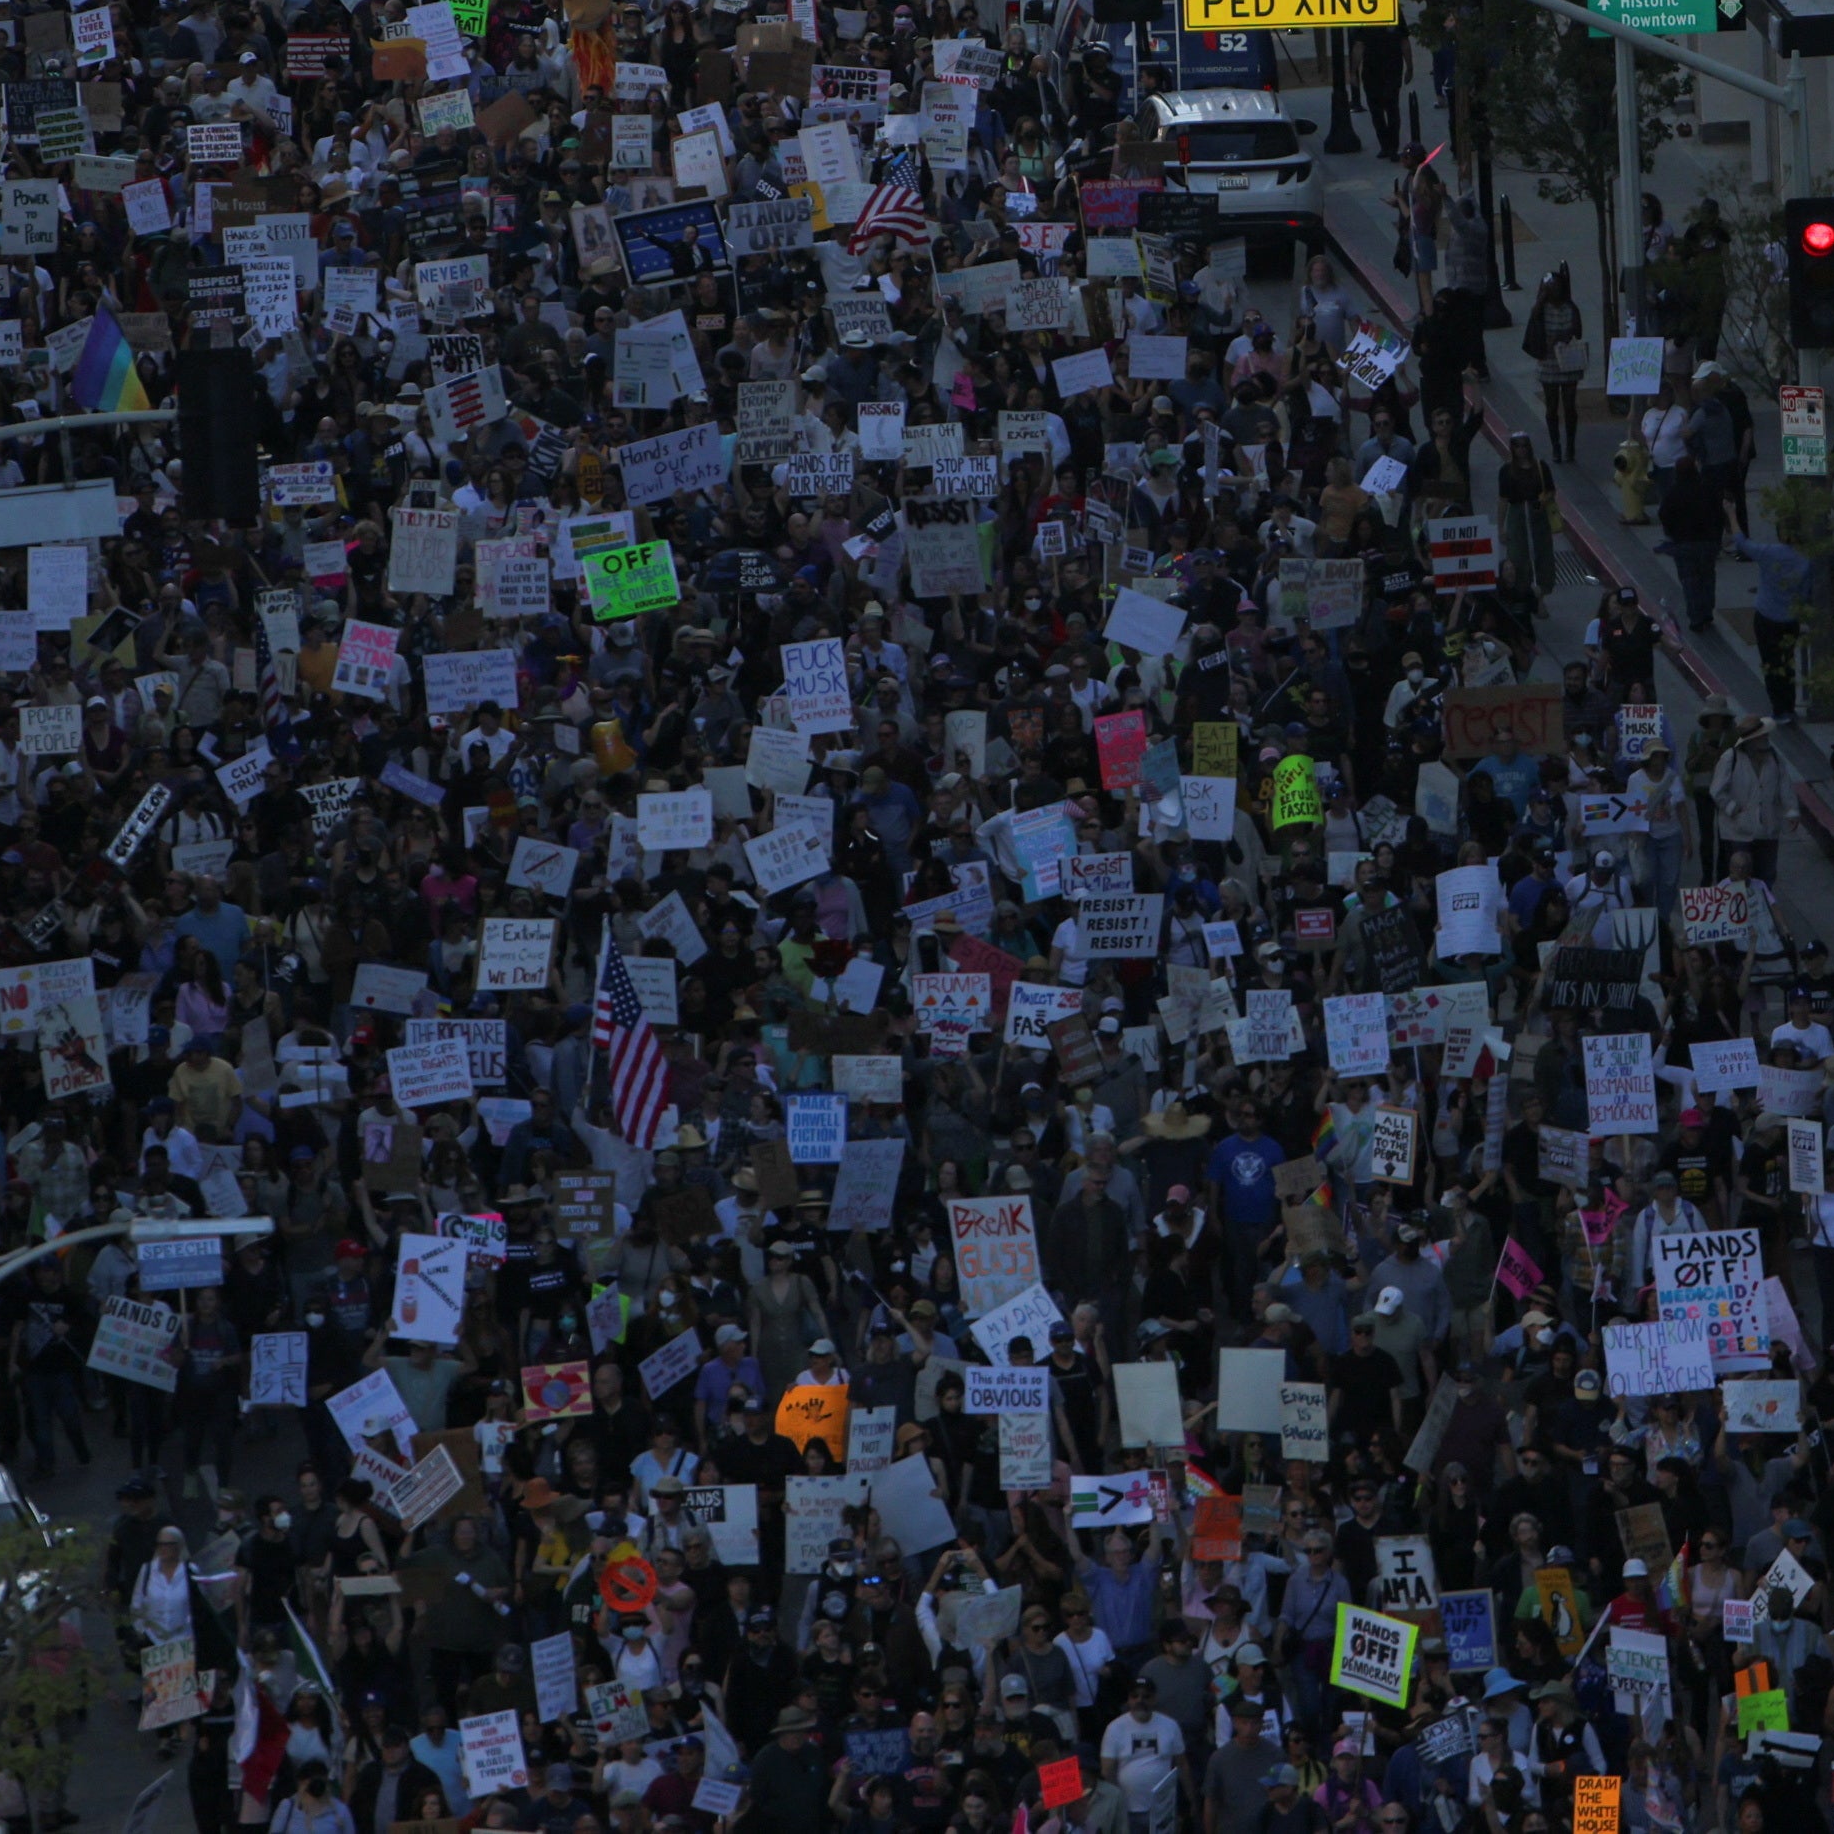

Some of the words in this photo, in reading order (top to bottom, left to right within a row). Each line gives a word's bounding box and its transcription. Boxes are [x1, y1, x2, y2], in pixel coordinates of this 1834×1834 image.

[1621, 12, 1697, 28] Downtown
[1220, 33, 1248, 52] 52
[823, 68, 878, 82] HANDS
[821, 79, 878, 101] OFF!
[13, 189, 49, 206] POWER
[734, 201, 811, 229] HANDS
[25, 224, 54, 245] PEOPLE
[749, 223, 800, 251] OFF
[189, 275, 240, 287] RESPECT
[190, 286, 246, 298] EXISTENCE
[1782, 398, 1795, 410] NO
[620, 439, 669, 467] Hands
[679, 427, 707, 452] off
[936, 458, 964, 473] STOP
[969, 457, 991, 471] THE
[934, 474, 998, 496] OLIGARCHY
[1442, 526, 1456, 540] DO
[1458, 525, 1478, 539] NOT
[603, 546, 652, 574] OFF
[787, 644, 842, 673] FUCK
[787, 671, 846, 695] MUSK
[28, 707, 74, 726] POWER
[1624, 706, 1658, 718] TRUMP
[1198, 725, 1230, 741] EAT
[1625, 722, 1656, 735] MUSK
[25, 732, 82, 752] PEOPLE
[231, 759, 259, 780] CUT
[1070, 856, 1129, 877] Resist
[1683, 887, 1731, 905] HANDS
[799, 1096, 832, 1111] MAKE
[792, 1112, 840, 1128] ORWELL
[1383, 1115, 1407, 1129] ALL
[791, 1128, 837, 1143] FICTION
[1374, 1123, 1408, 1140] POWER
[792, 1145, 832, 1159] AGAIN
[1374, 1147, 1408, 1164] PEOPLE
[143, 1241, 216, 1260] SPEECH!
[1660, 1229, 1757, 1261] HANDS
[957, 1242, 1035, 1279] GLASS
[106, 1295, 160, 1325] HANDS
[1603, 1318, 1704, 1350] OVERTHROW
[1638, 1347, 1667, 1370] THE
[1609, 1363, 1709, 1396] OLIGARCHS
[971, 1388, 1041, 1408] OBVIOUS
[853, 1423, 891, 1437] FREEDOM
[861, 1440, 880, 1454] NOT
[849, 1457, 889, 1473] FASCISM
[1352, 1616, 1400, 1645] HANDS
[1341, 1655, 1400, 1687] DEMOCRACY
[467, 1734, 516, 1751] DEMOCRACY
[1579, 1778, 1617, 1790] DRAIN
[1579, 1793, 1602, 1804] THE
[1578, 1806, 1617, 1818] WHITE
[1577, 1819, 1616, 1832] HOUSE
